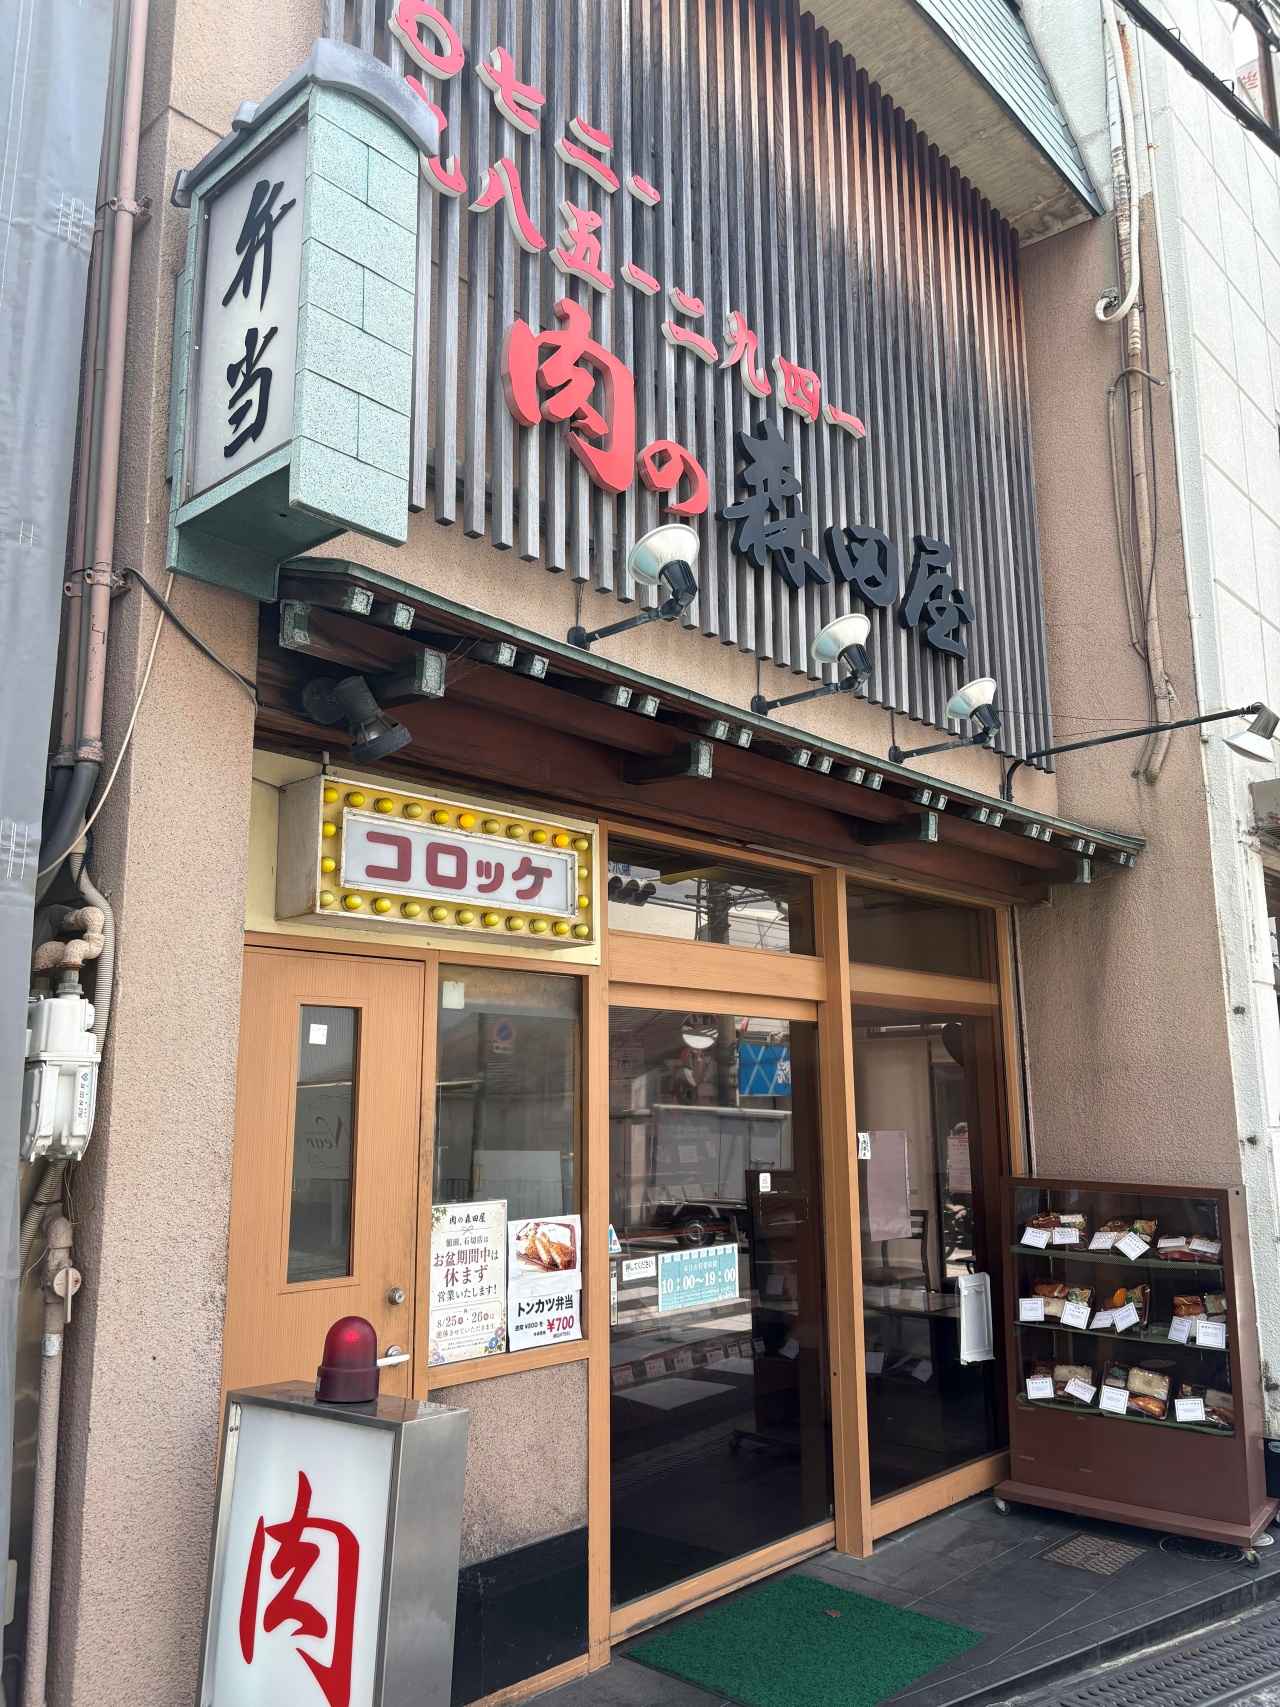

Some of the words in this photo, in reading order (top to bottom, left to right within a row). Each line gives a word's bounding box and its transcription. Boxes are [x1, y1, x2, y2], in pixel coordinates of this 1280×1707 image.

[221, 179, 297, 459] 弁当
[364, 831, 553, 900] コロッケ
[449, 1211, 487, 1225] 肉の森田屋
[433, 1248, 499, 1268] お盆期間中は
[444, 1265, 489, 1288] 休まず
[517, 1295, 574, 1318] トンカツ弁当
[547, 1315, 574, 1332] ¥700
[239, 1471, 360, 1707] 肉
